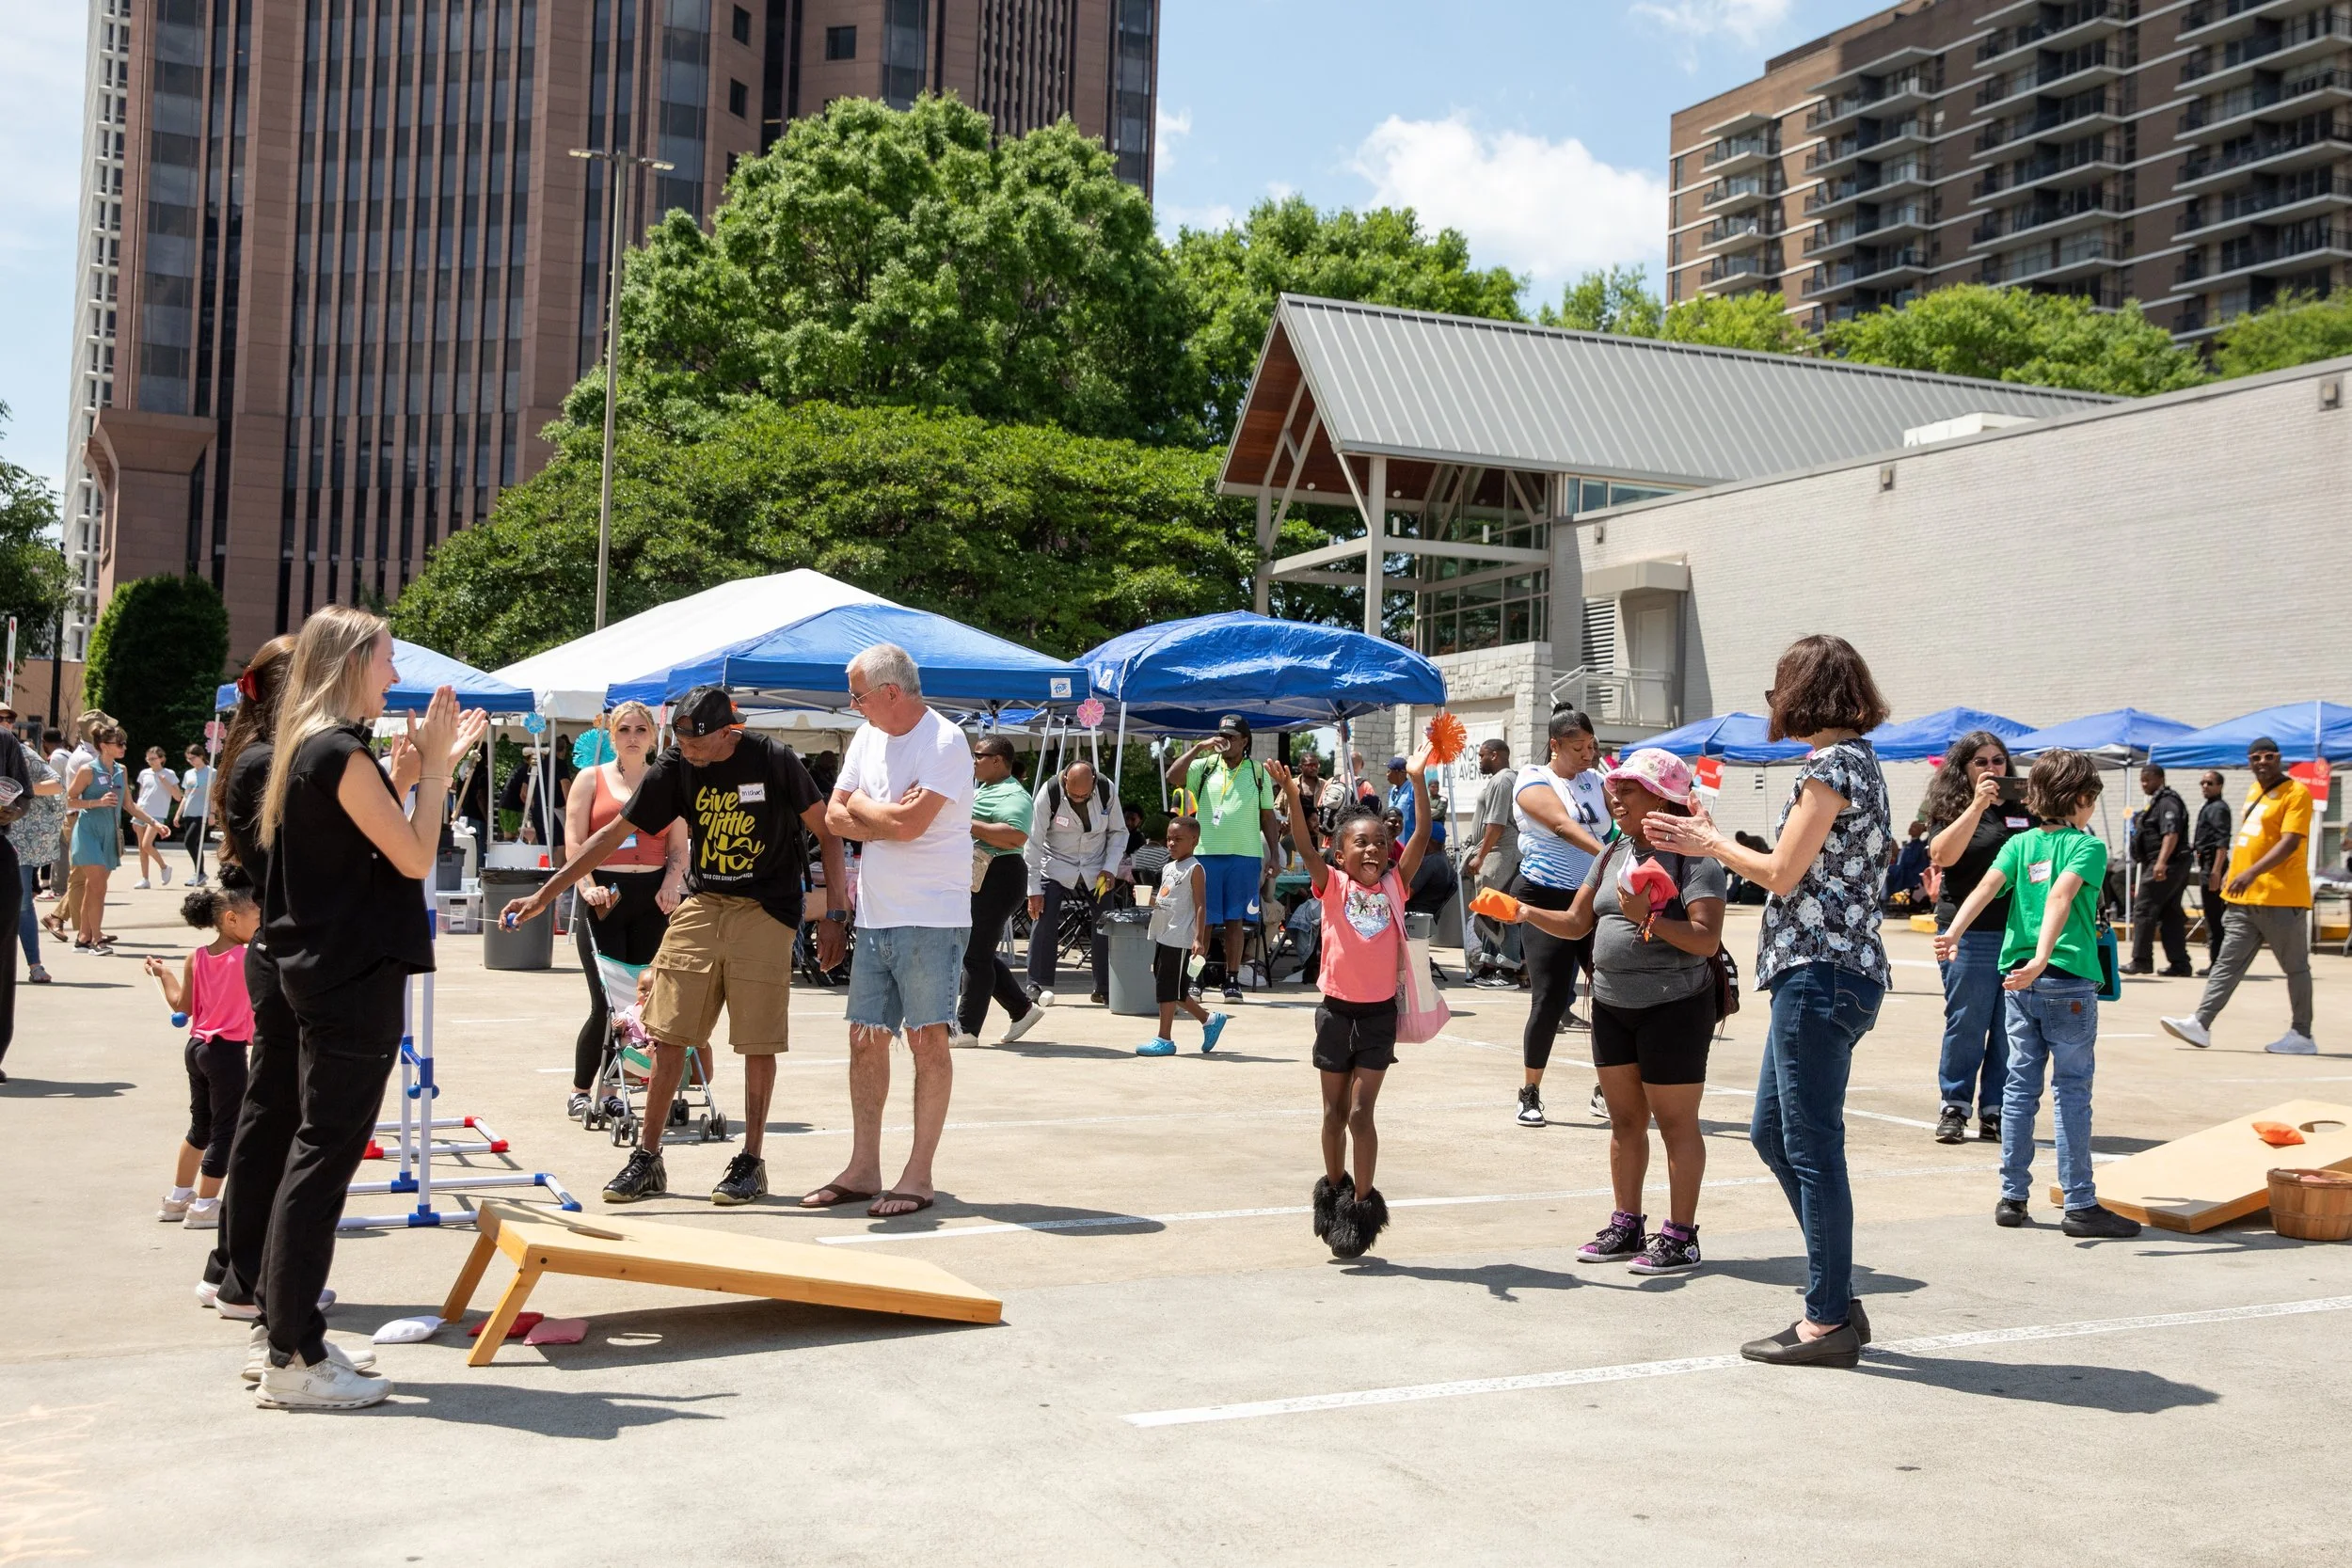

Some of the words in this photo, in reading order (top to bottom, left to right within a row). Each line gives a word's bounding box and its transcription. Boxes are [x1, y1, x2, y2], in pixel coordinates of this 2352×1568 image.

[1458, 763, 1494, 781] AVEN
[696, 785, 739, 812] Give
[699, 811, 712, 826] a
[707, 811, 755, 840] little
[733, 872, 754, 881] CAMPAIGN
